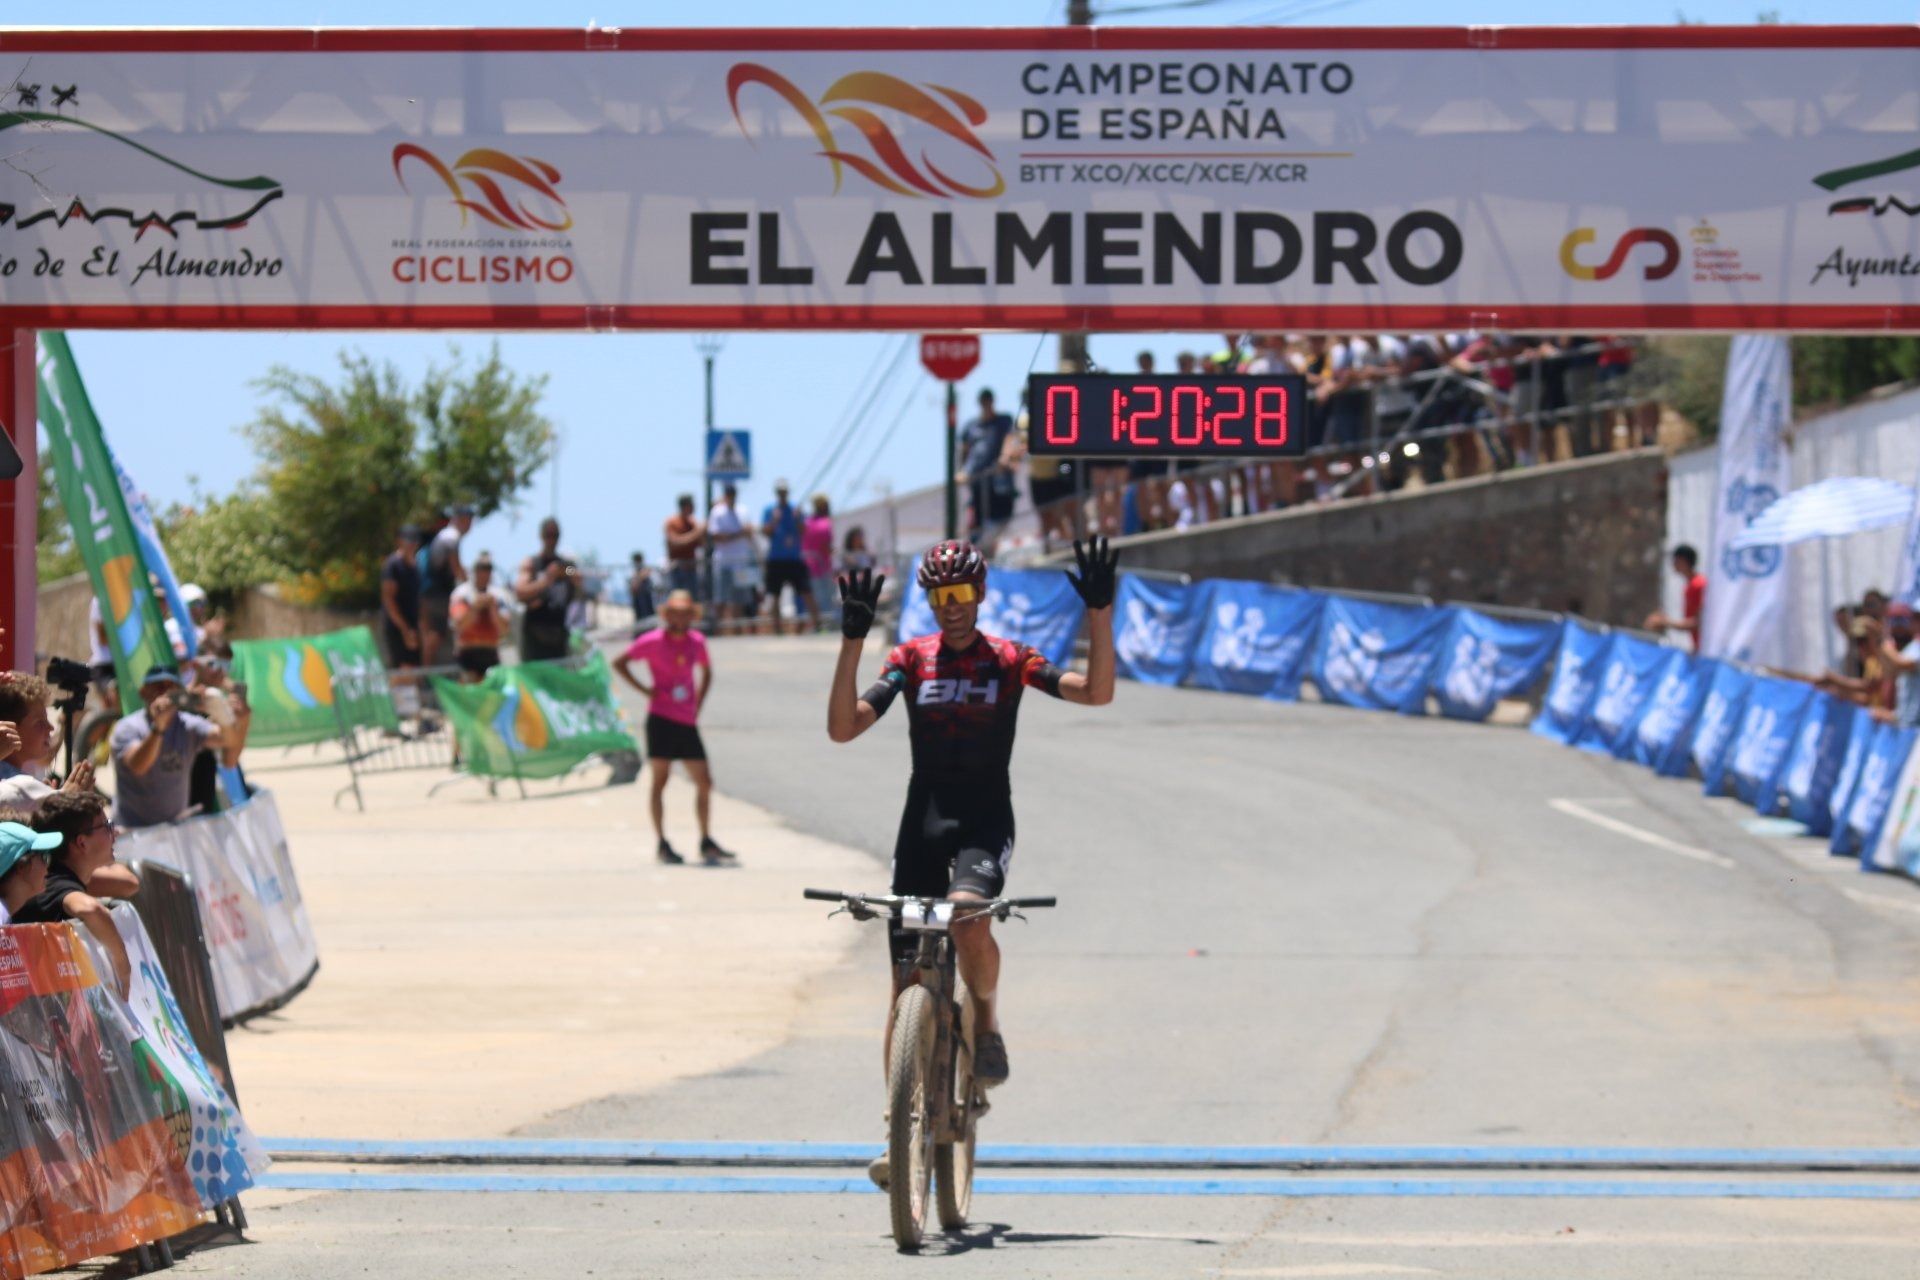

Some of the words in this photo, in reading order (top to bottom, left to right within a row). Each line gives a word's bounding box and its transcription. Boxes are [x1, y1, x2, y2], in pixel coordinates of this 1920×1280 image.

[1021, 62, 1354, 95] CAMPEONATO
[1021, 108, 1081, 140] DE
[1100, 99, 1287, 140] ESPAÑA
[1020, 164, 1064, 183] BTT
[1071, 162, 1308, 186] XCO/XCC/XCE/XCR
[391, 239, 421, 249] REAL
[427, 237, 502, 249] FEDERACIÓN
[509, 238, 573, 249] ESPAÑOLA
[689, 211, 814, 287] EL
[846, 209, 1464, 288] ALMENDRO
[33, 247, 65, 277] de
[81, 245, 120, 278] El
[129, 246, 284, 288] Almendro
[392, 255, 573, 284] CICLISMO
[925, 341, 977, 360] STOP
[916, 678, 999, 705] BH
